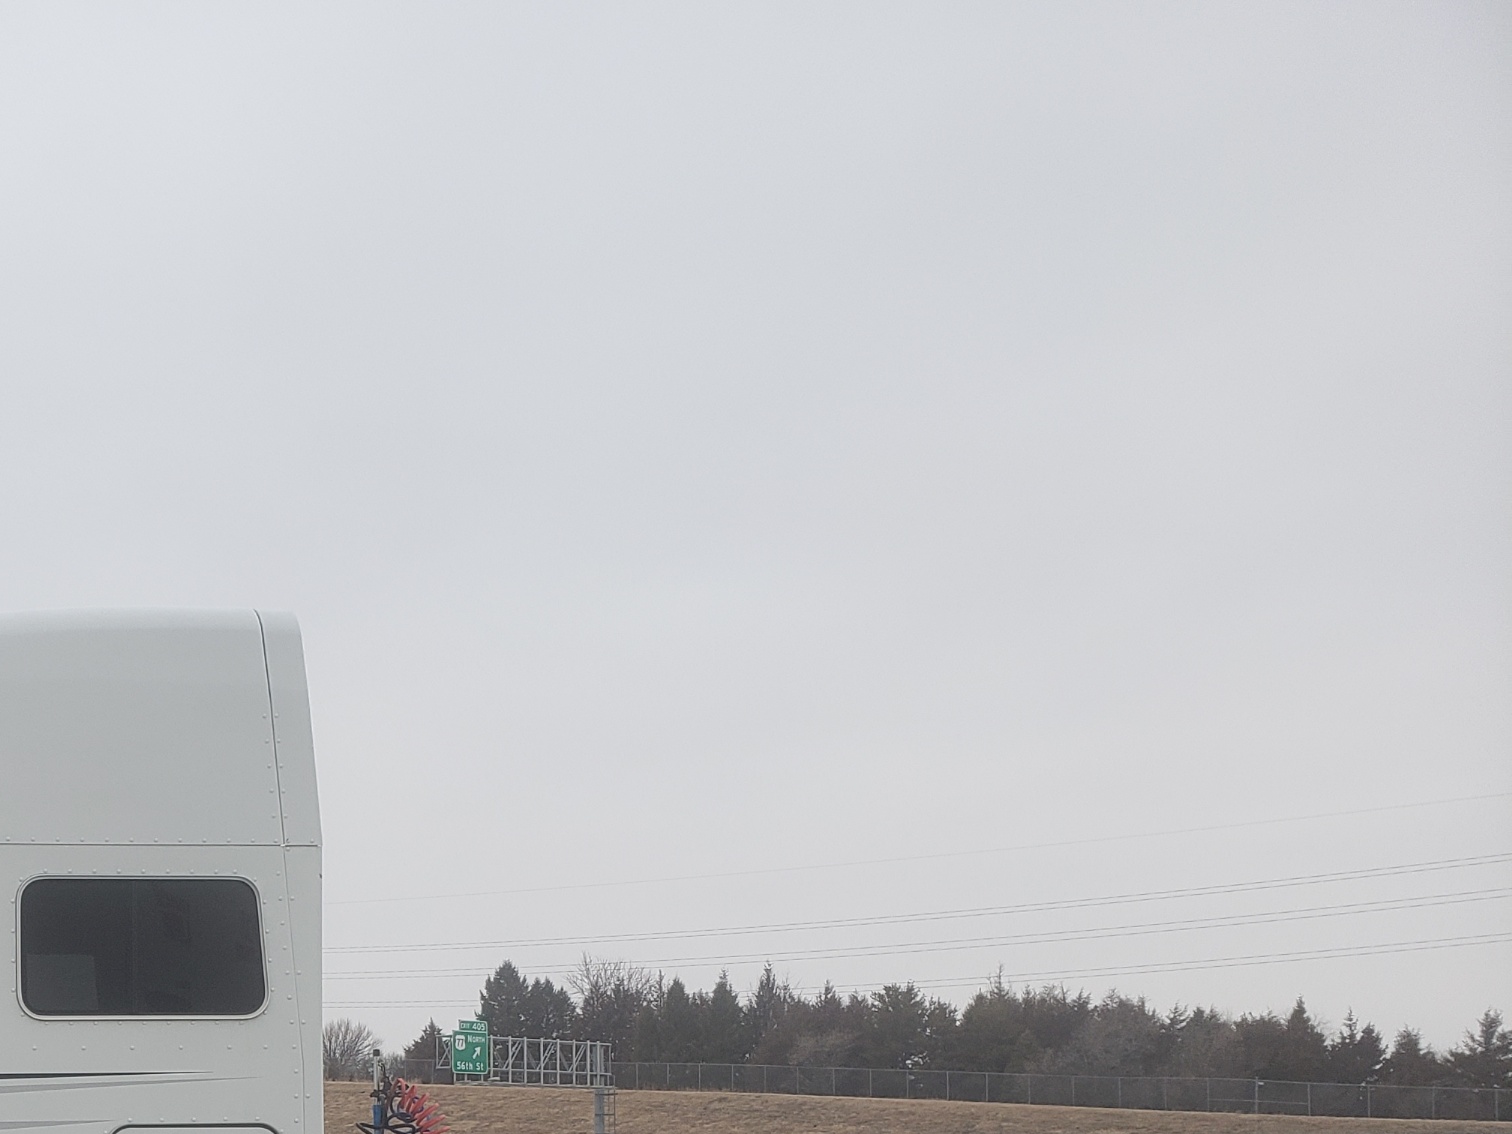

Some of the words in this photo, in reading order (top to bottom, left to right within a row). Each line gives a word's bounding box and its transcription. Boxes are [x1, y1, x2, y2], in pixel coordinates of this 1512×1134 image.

[472, 1023, 485, 1031] 405
[456, 1061, 473, 1070] 56th
[476, 1062, 484, 1071] St
